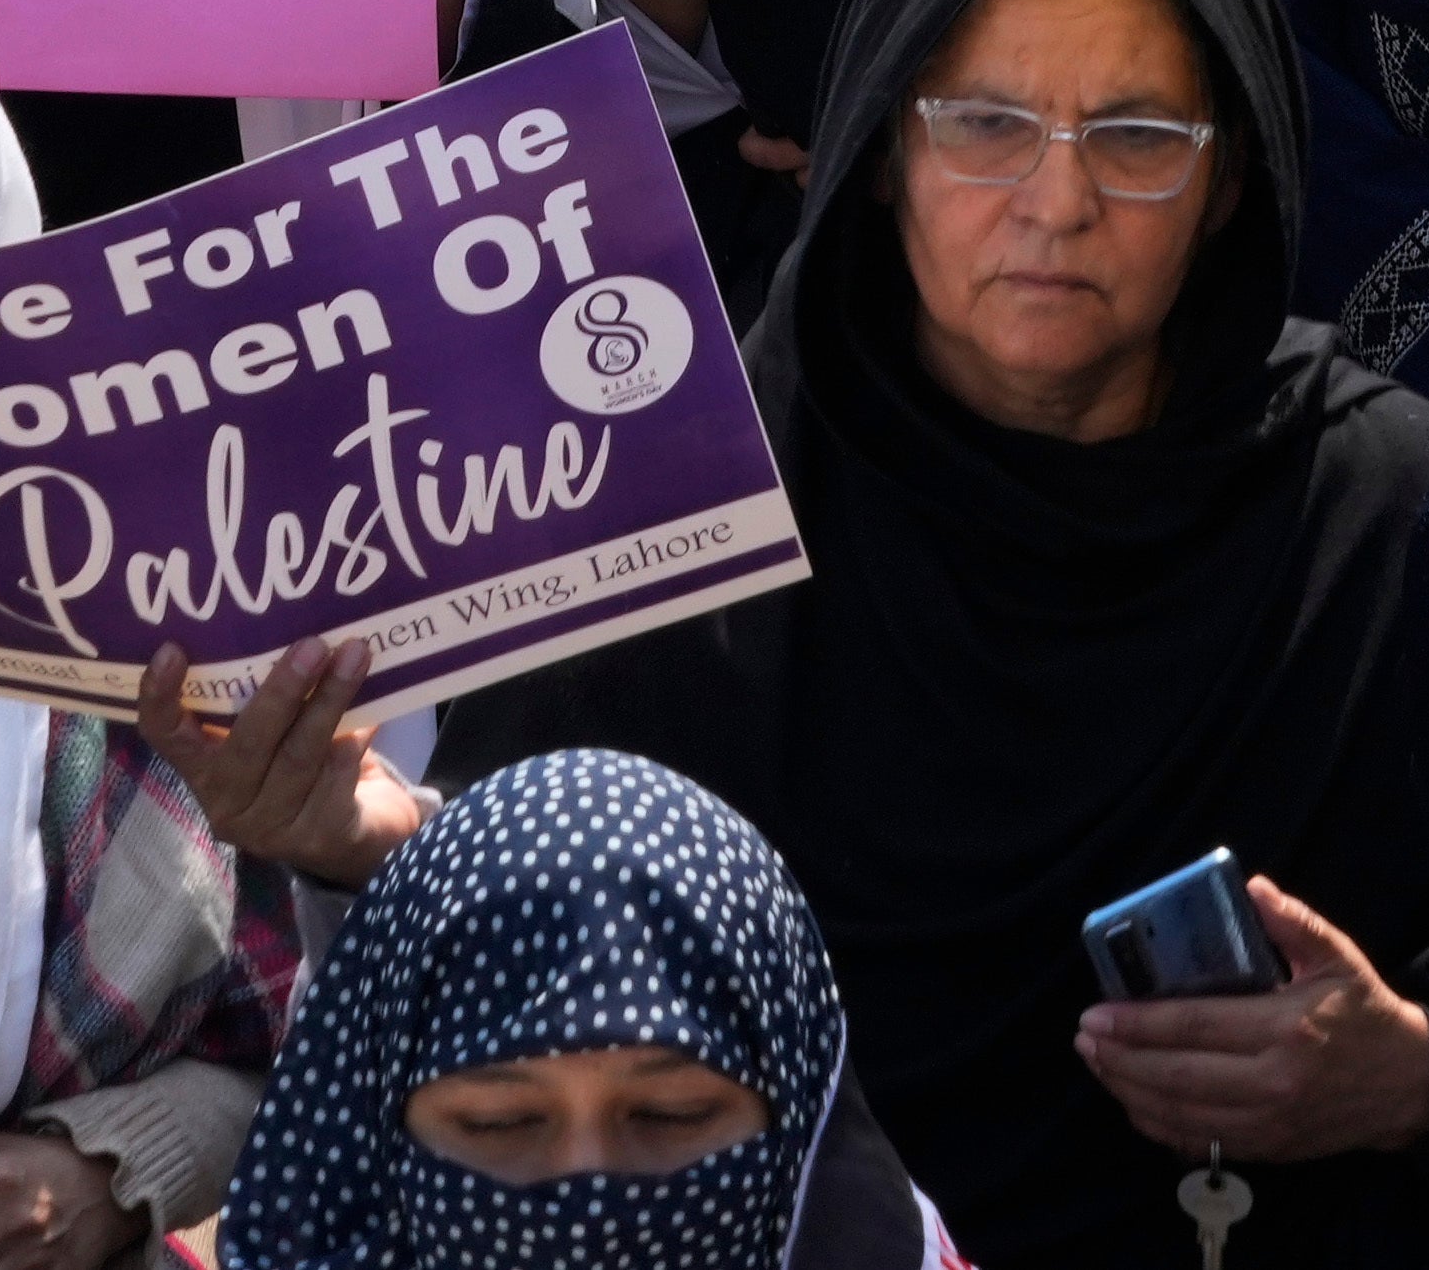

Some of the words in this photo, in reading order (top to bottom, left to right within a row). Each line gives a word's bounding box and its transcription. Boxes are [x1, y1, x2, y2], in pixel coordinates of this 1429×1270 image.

[103, 200, 303, 317] For
[328, 106, 570, 235] The
[432, 180, 595, 317] Of
[593, 517, 734, 584] Lahore
